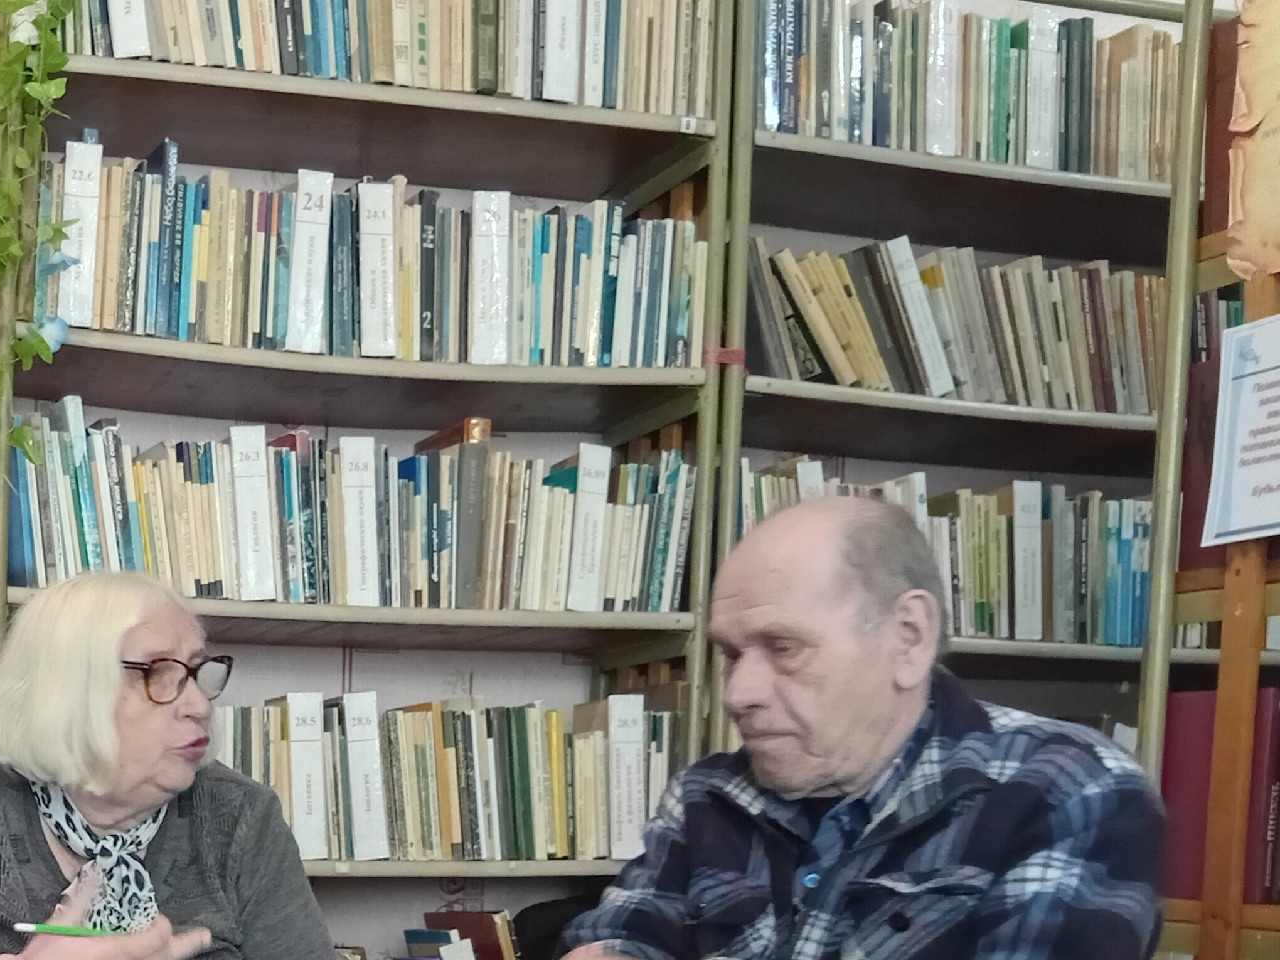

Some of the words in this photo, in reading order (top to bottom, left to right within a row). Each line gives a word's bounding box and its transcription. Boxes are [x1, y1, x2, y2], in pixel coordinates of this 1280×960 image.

[301, 191, 325, 213] 24
[422, 311, 432, 329] 2
[238, 451, 260, 463] 26.3
[295, 716, 317, 727] 28.5
